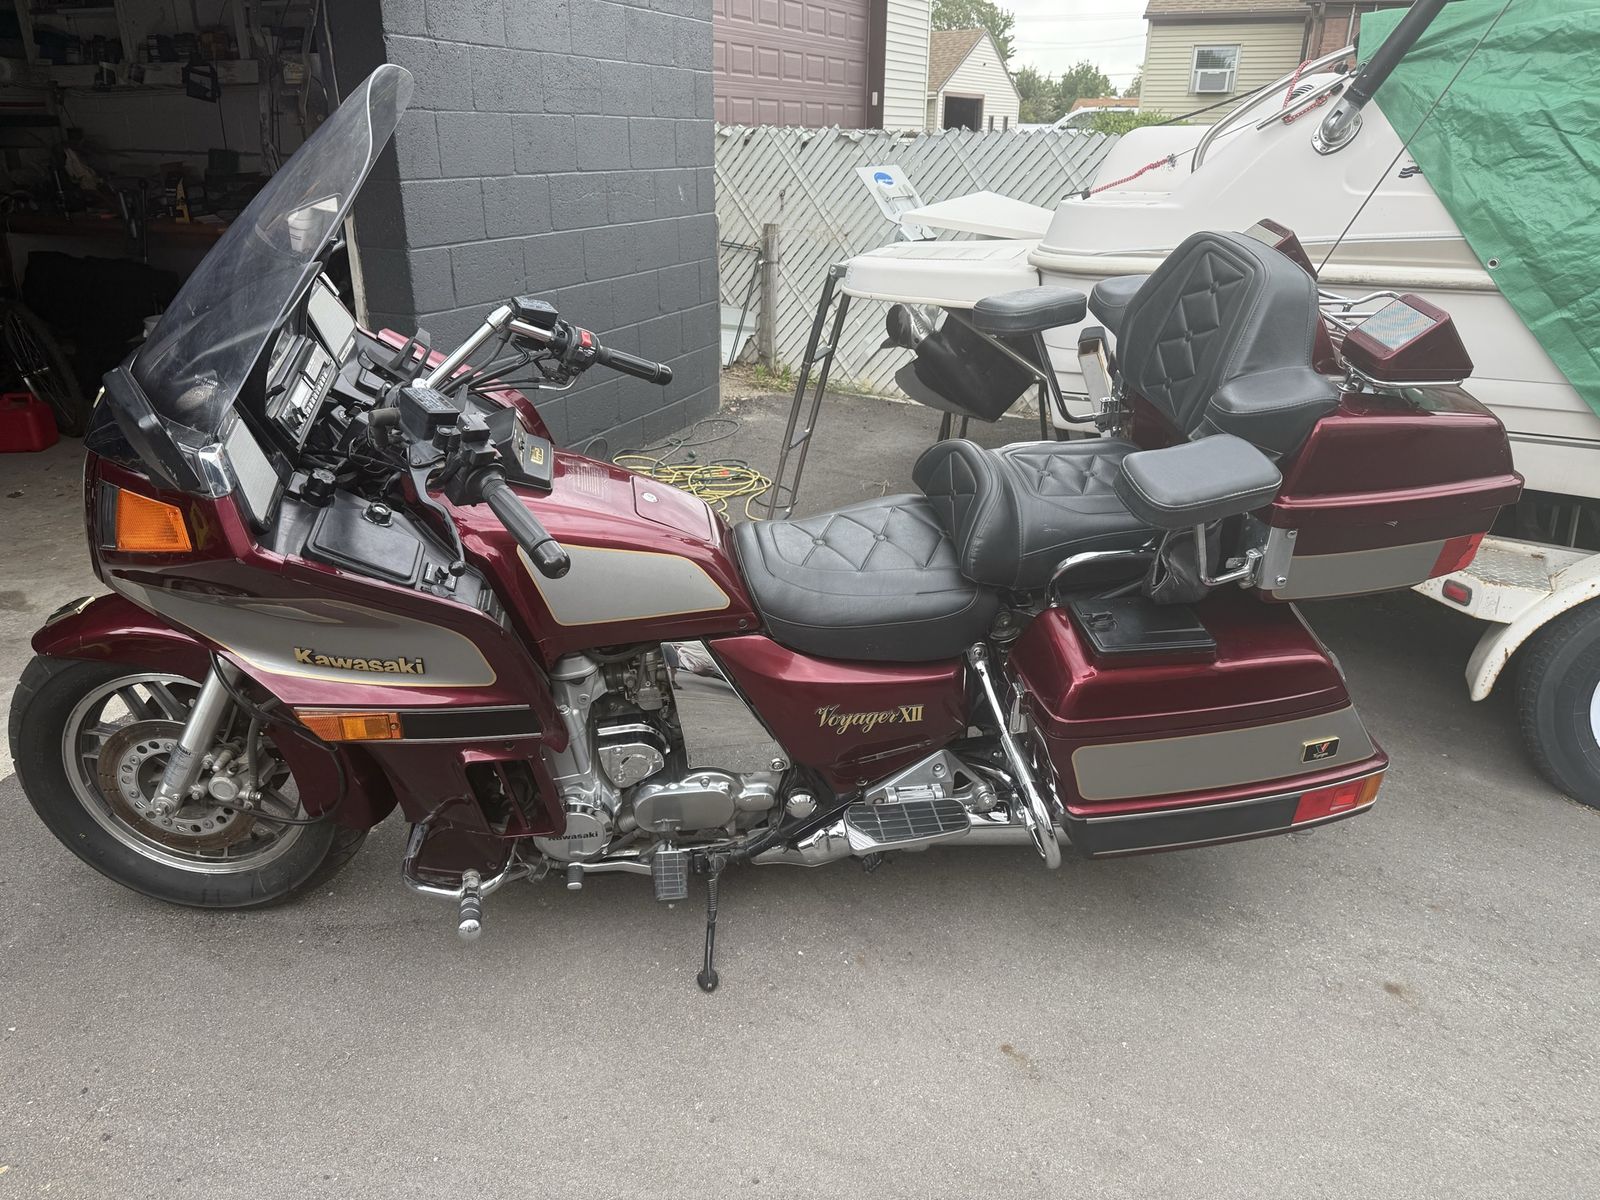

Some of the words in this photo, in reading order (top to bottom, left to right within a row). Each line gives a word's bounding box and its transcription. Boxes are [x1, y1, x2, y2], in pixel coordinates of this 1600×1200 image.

[293, 646, 425, 674] Kawasaki
[815, 704, 899, 735] Voyager
[899, 704, 924, 723] XII
